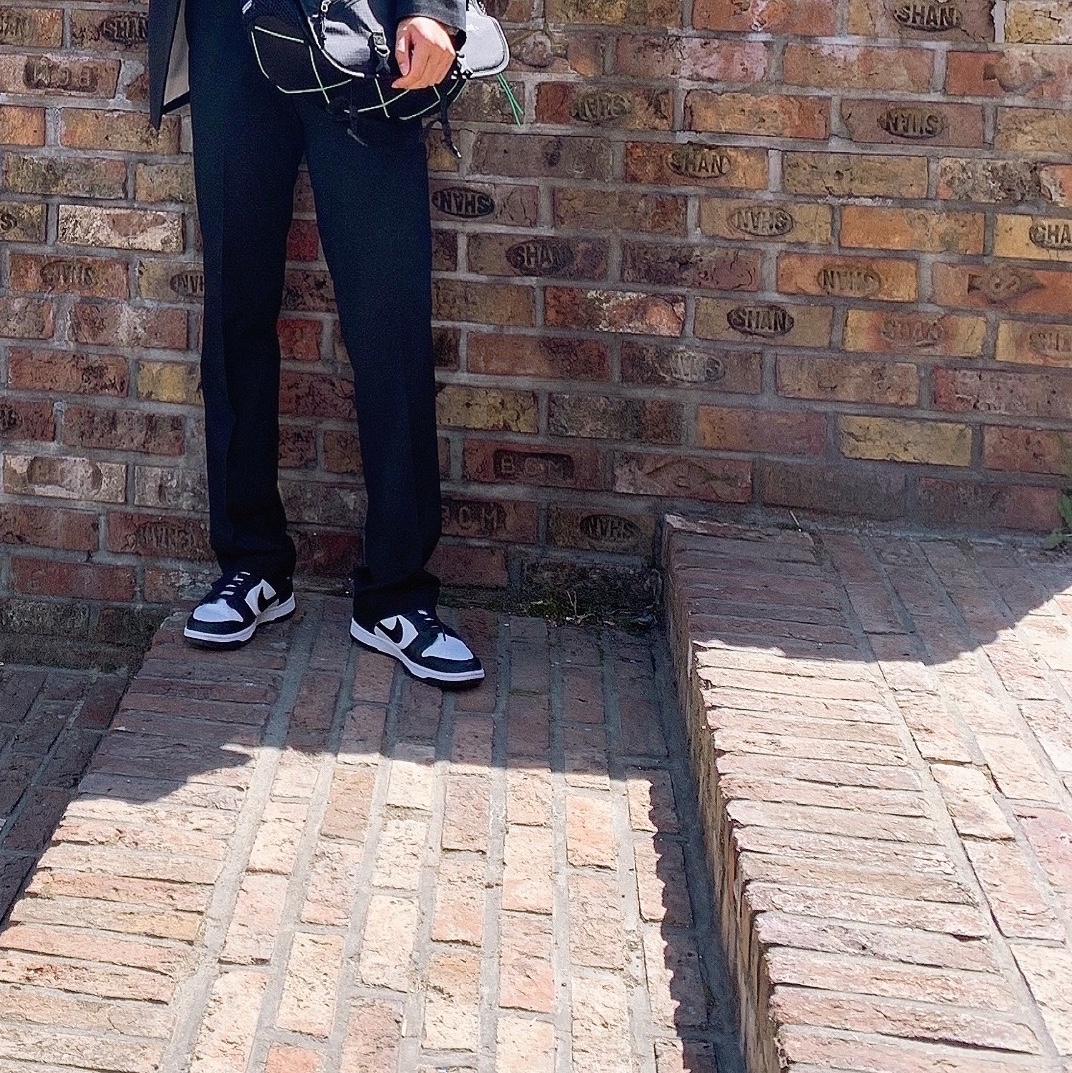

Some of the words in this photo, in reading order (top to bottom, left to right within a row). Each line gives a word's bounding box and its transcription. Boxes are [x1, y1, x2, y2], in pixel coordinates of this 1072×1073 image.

[896, 6, 953, 28] SHAN
[439, 190, 492, 216] SHAN
[736, 210, 790, 235] SHAN
[514, 243, 568, 270] SHAN
[729, 308, 788, 332] SHAN
